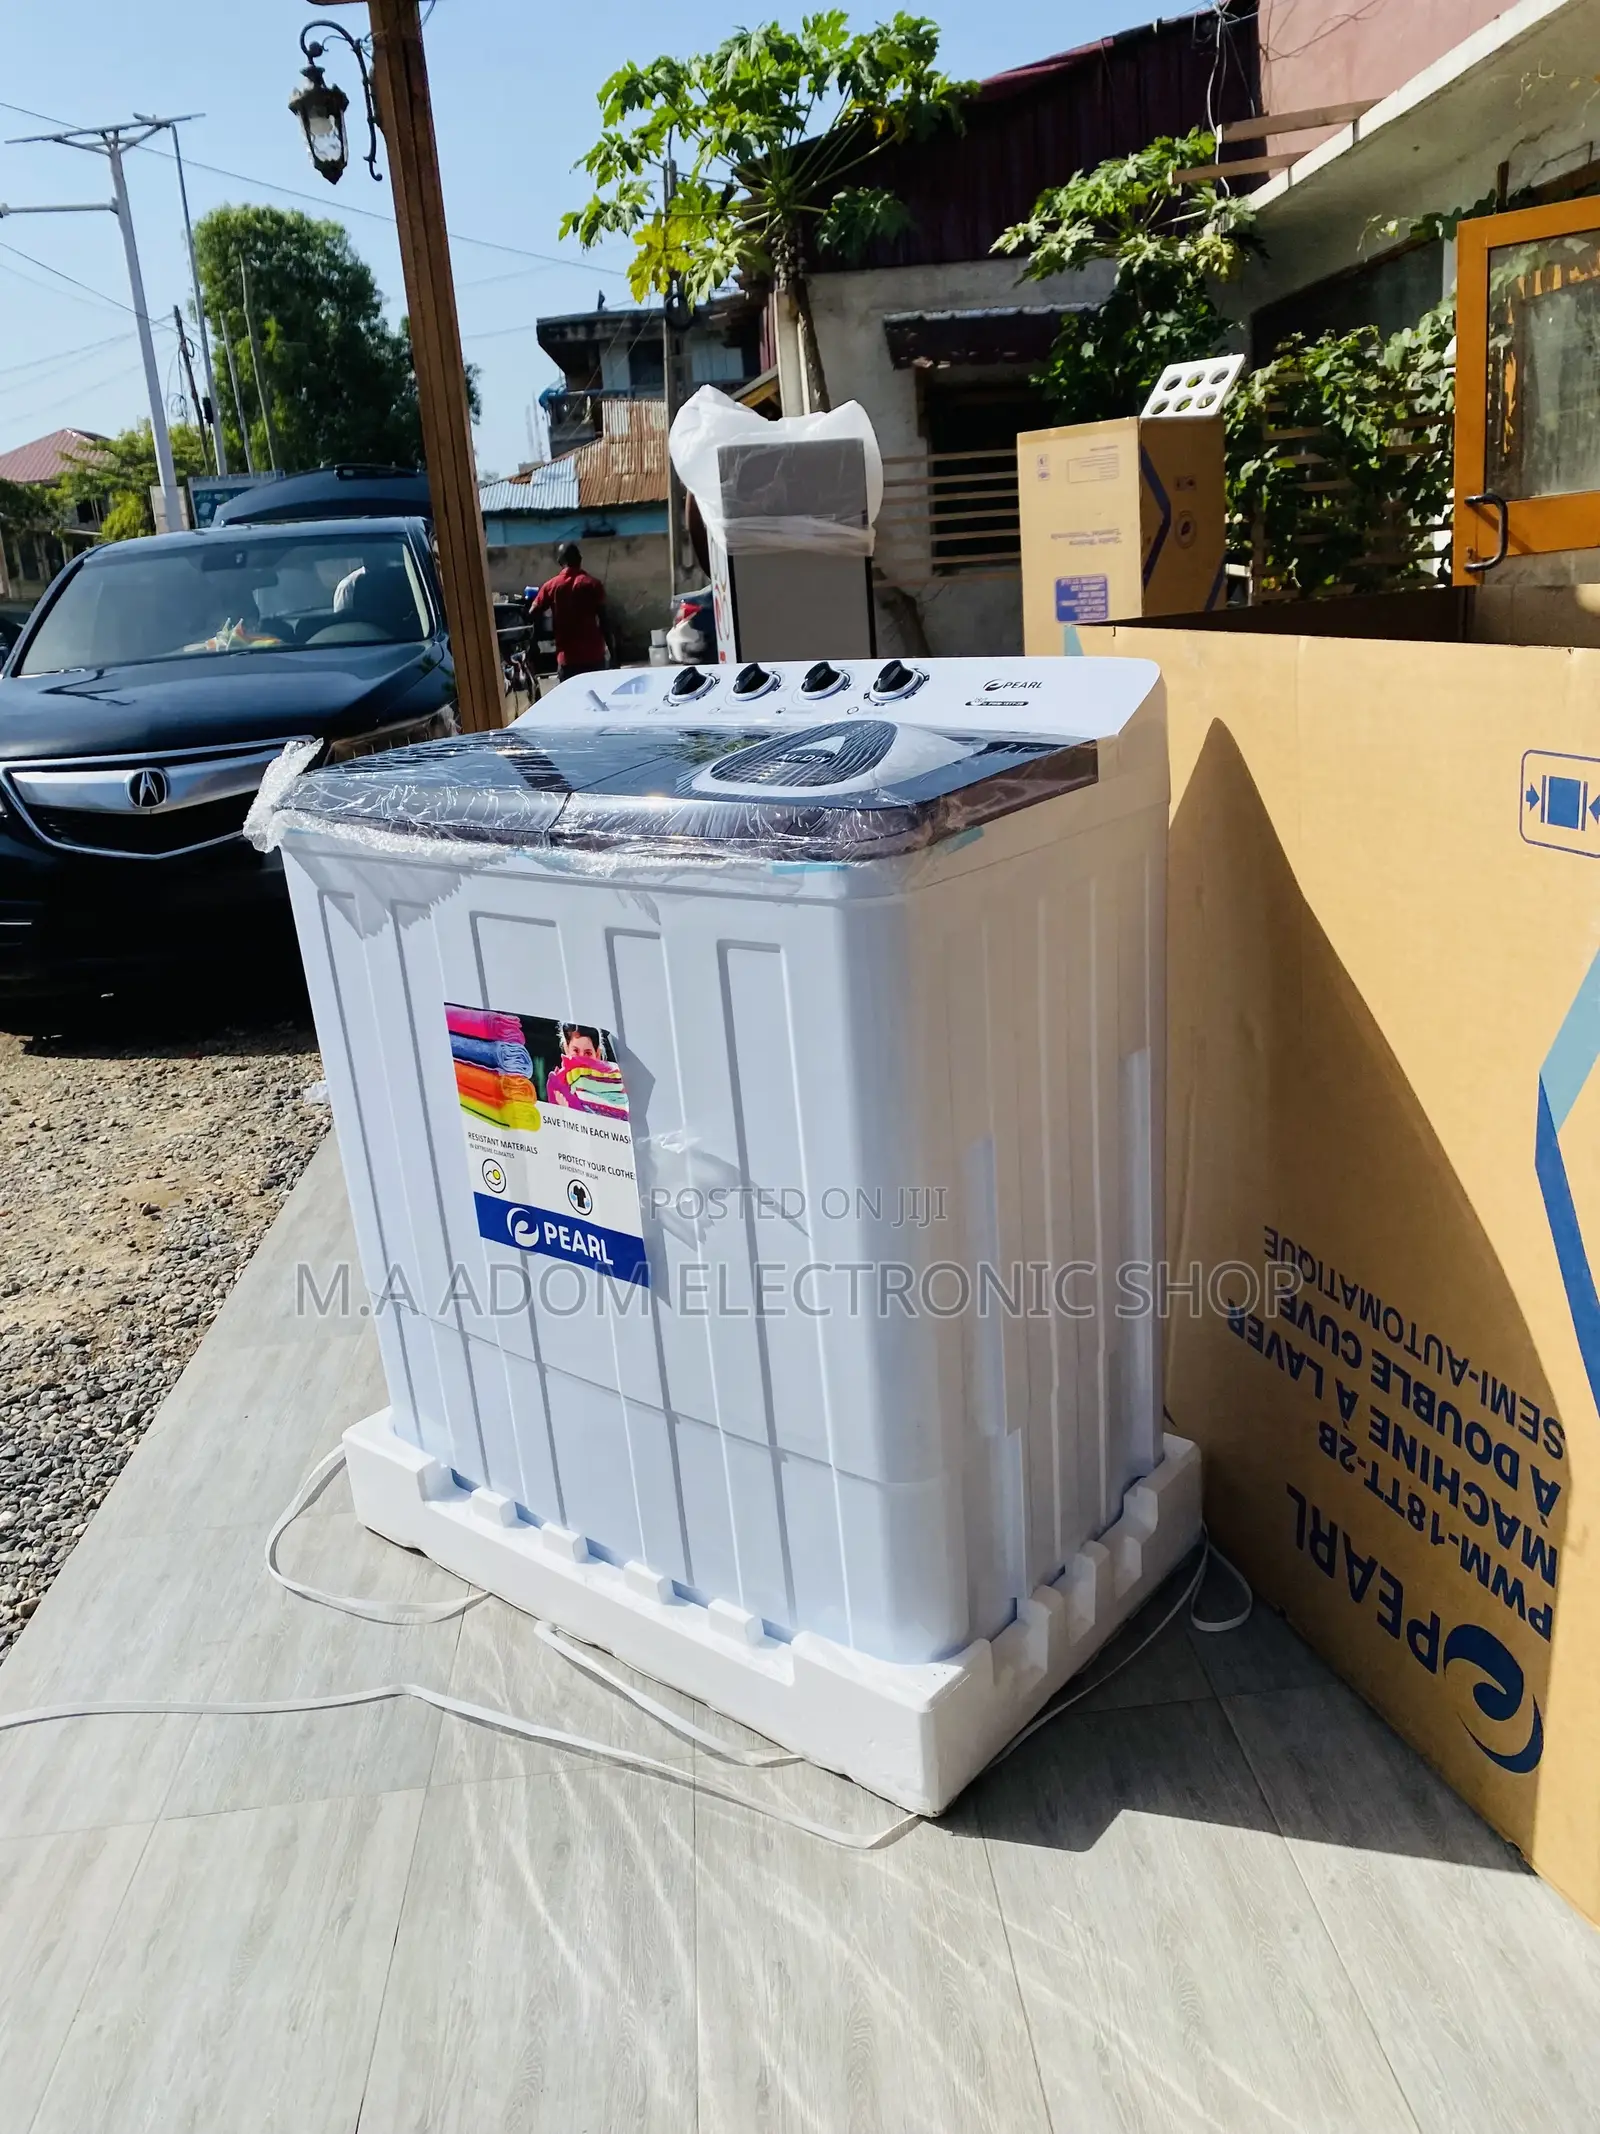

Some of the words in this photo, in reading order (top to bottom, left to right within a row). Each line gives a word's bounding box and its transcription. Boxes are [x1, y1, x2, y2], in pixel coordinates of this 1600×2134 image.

[1003, 680, 1044, 689] PEARL
[467, 1131, 499, 1147] RESISTANT
[500, 1140, 538, 1155] MATERIALS
[542, 1115, 561, 1128] SAVE
[562, 1120, 580, 1132] TIME
[580, 1124, 589, 1135] IN
[589, 1125, 609, 1139] EACH
[558, 1152, 586, 1167] PROTECT
[587, 1159, 606, 1173] YOUR
[607, 1166, 636, 1180] CLOTHE
[543, 1221, 614, 1266] PEARL
[1228, 1298, 1324, 1401] LAVER
[1264, 1225, 1566, 1462] SEMI-AUTOMATIQUE
[1280, 1284, 1363, 1370] CUVE
[1370, 1348, 1520, 1491] DOUBLE
[1318, 1420, 1553, 1643] PWM-18TT-2B
[1368, 1405, 1557, 1588] MACHINE
[1530, 1464, 1562, 1530] À
[1286, 1482, 1440, 1674] PEARL
